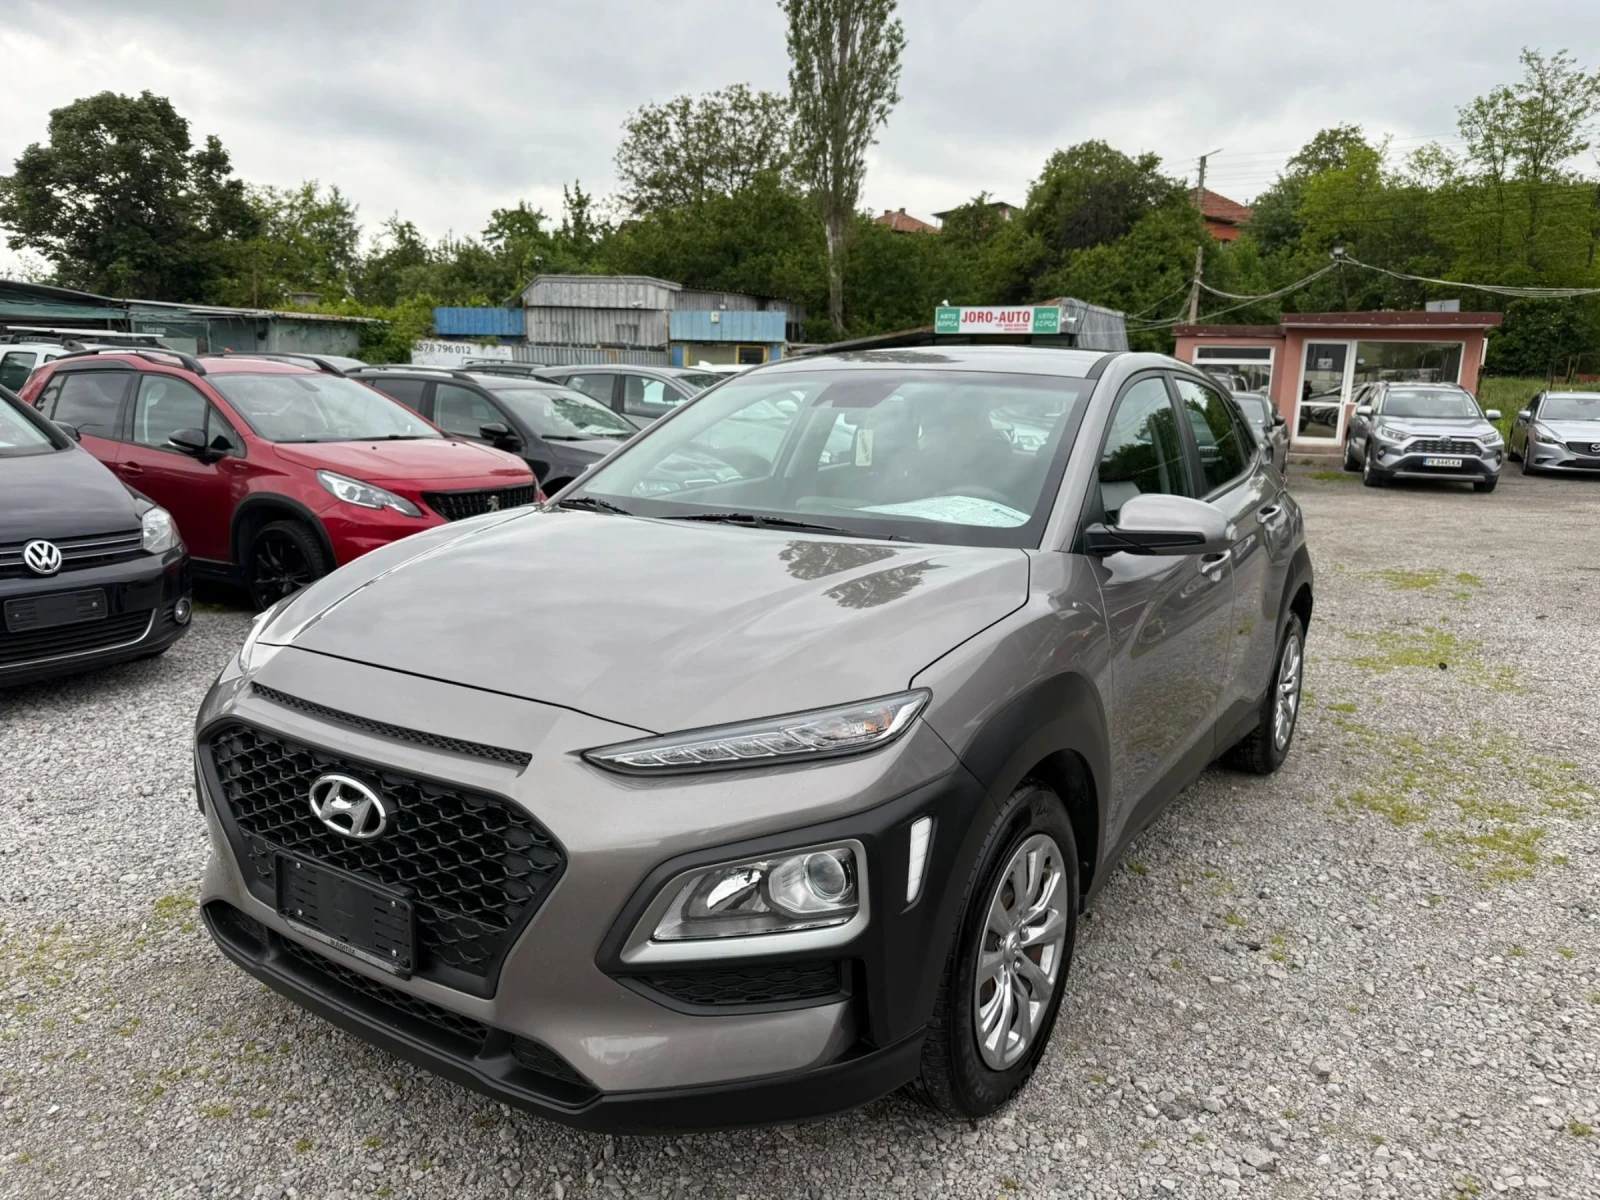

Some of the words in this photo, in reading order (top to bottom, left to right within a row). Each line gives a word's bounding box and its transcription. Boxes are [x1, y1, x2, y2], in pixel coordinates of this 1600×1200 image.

[961, 311, 1031, 323] JORO-AUTO
[437, 344, 454, 353] 796
[455, 345, 471, 354] 012
